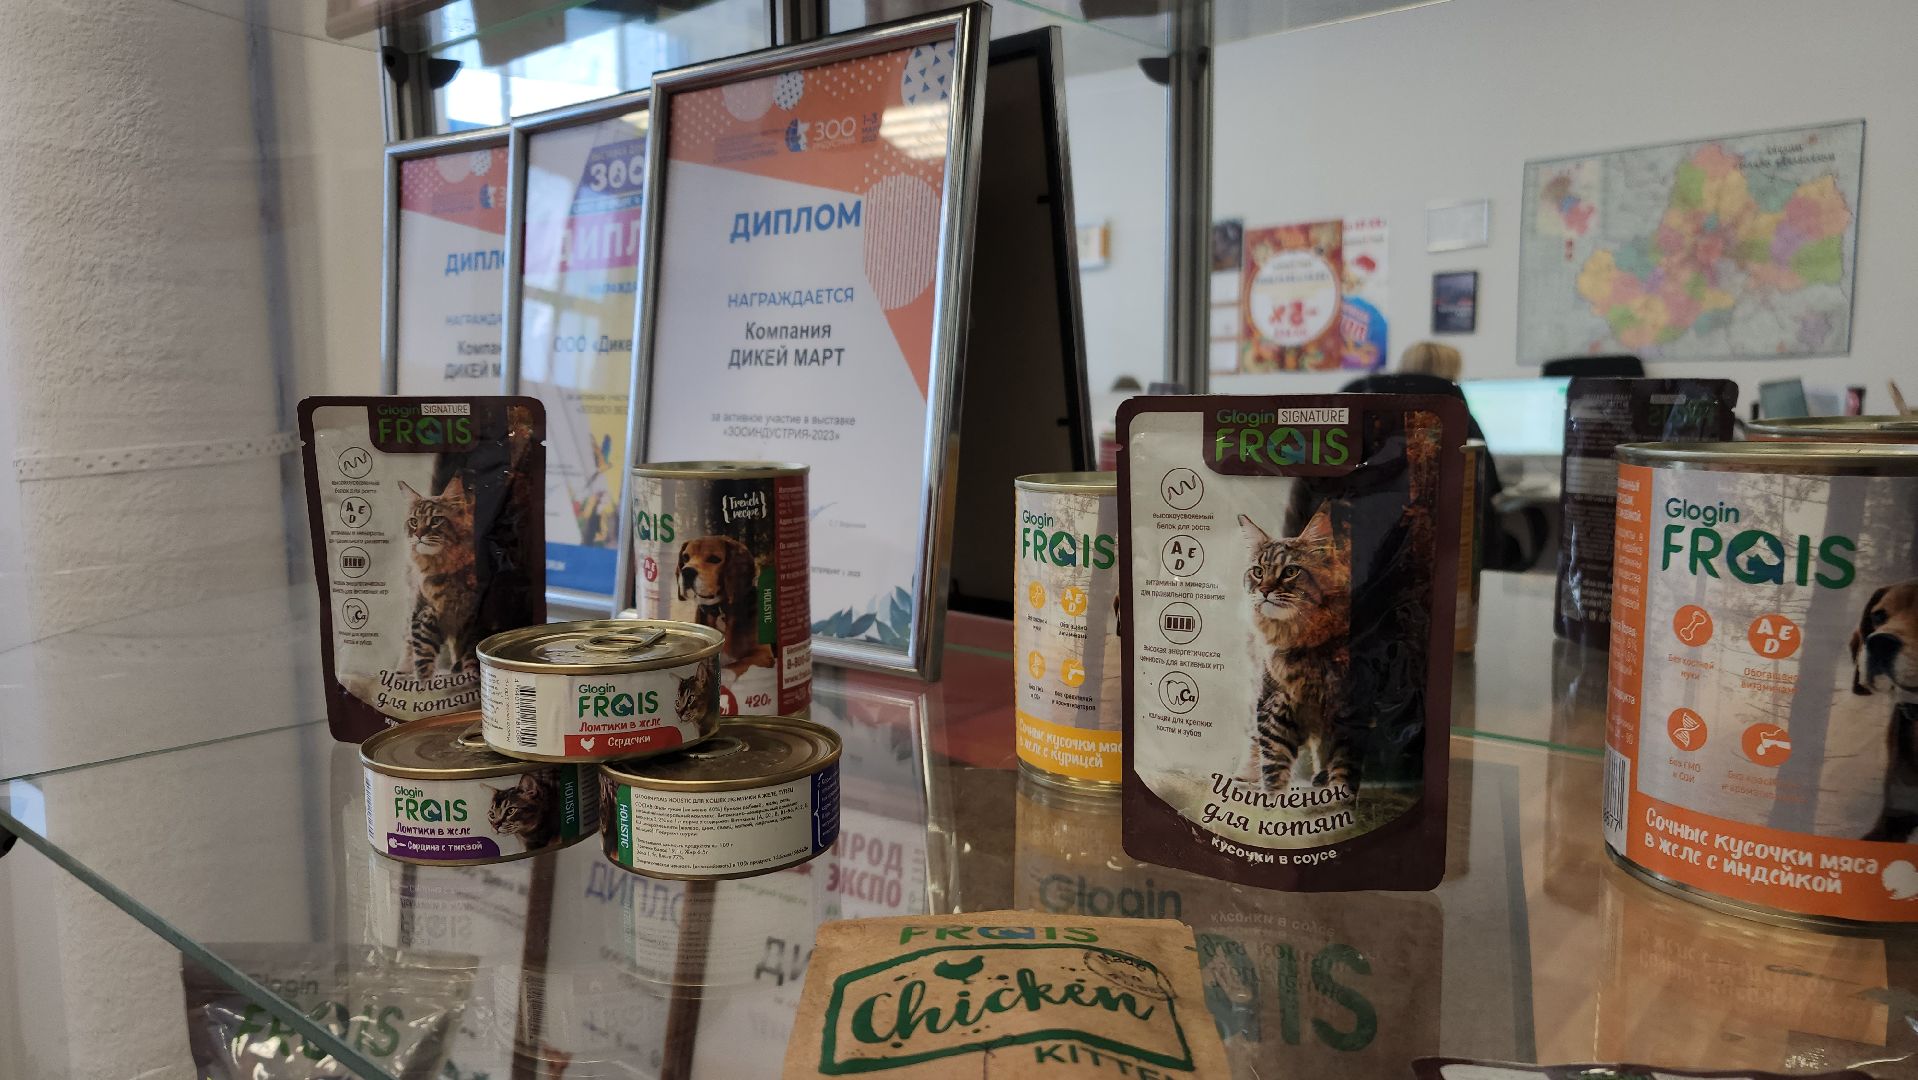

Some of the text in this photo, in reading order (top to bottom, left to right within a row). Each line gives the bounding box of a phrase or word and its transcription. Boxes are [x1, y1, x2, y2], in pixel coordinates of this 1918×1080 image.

[729, 200, 862, 244] ДИПЛОМ
[444, 250, 504, 276] ДИПЛ
[727, 287, 854, 308] НАГРАЖДАЕТСЯ
[745, 322, 832, 340] Компания
[457, 340, 502, 355] Компан
[728, 345, 845, 369] ДИКЕЙ МАРТ
[424, 405, 468, 415] SIGNATURE
[1216, 408, 1345, 427] Glogin SIGNATURE
[377, 416, 472, 445] FRAIS
[1215, 427, 1349, 466] FRAIS
[1022, 510, 1054, 529] Glogin
[1665, 497, 1740, 527] Glogin
[637, 510, 675, 543] AIS
[1022, 527, 1116, 570] FRAIS
[1171, 541, 1196, 558] A E
[1661, 524, 1857, 590] FRAIS
[1174, 559, 1185, 570] D
[1757, 618, 1794, 641] A E
[1763, 638, 1780, 654] D
[379, 669, 479, 693] Цыплёнок
[578, 683, 616, 696] Glogin
[377, 689, 481, 713] для котят
[578, 691, 659, 718] FRAIS
[1180, 688, 1196, 702] Ca
[579, 717, 661, 733] Ломтики в желе
[607, 735, 651, 748] Сердечки
[1047, 732, 1096, 752] кусочки
[1100, 741, 1122, 754] мяс
[1050, 748, 1104, 768] курицей
[394, 785, 423, 798] Glogin
[1211, 772, 1351, 809] Цыплёнок
[394, 798, 468, 822] FRAIS
[566, 781, 575, 825] HOLISTIC
[396, 822, 436, 836] Ломтики
[446, 826, 471, 835] желе
[620, 803, 630, 849] HOLISTIC
[1201, 803, 1354, 837] для котят
[448, 841, 483, 851] тыквой
[1211, 836, 1337, 866] кусочки в соусе
[1646, 807, 1879, 875] Сочные кусочки мяса
[1644, 831, 1843, 895] в желе с индейкой
[825, 862, 902, 908] ЭКСПО
[900, 925, 1099, 945] FRAIS
[1196, 933, 1378, 1052] AIS
[850, 967, 1156, 1044] Chicken
